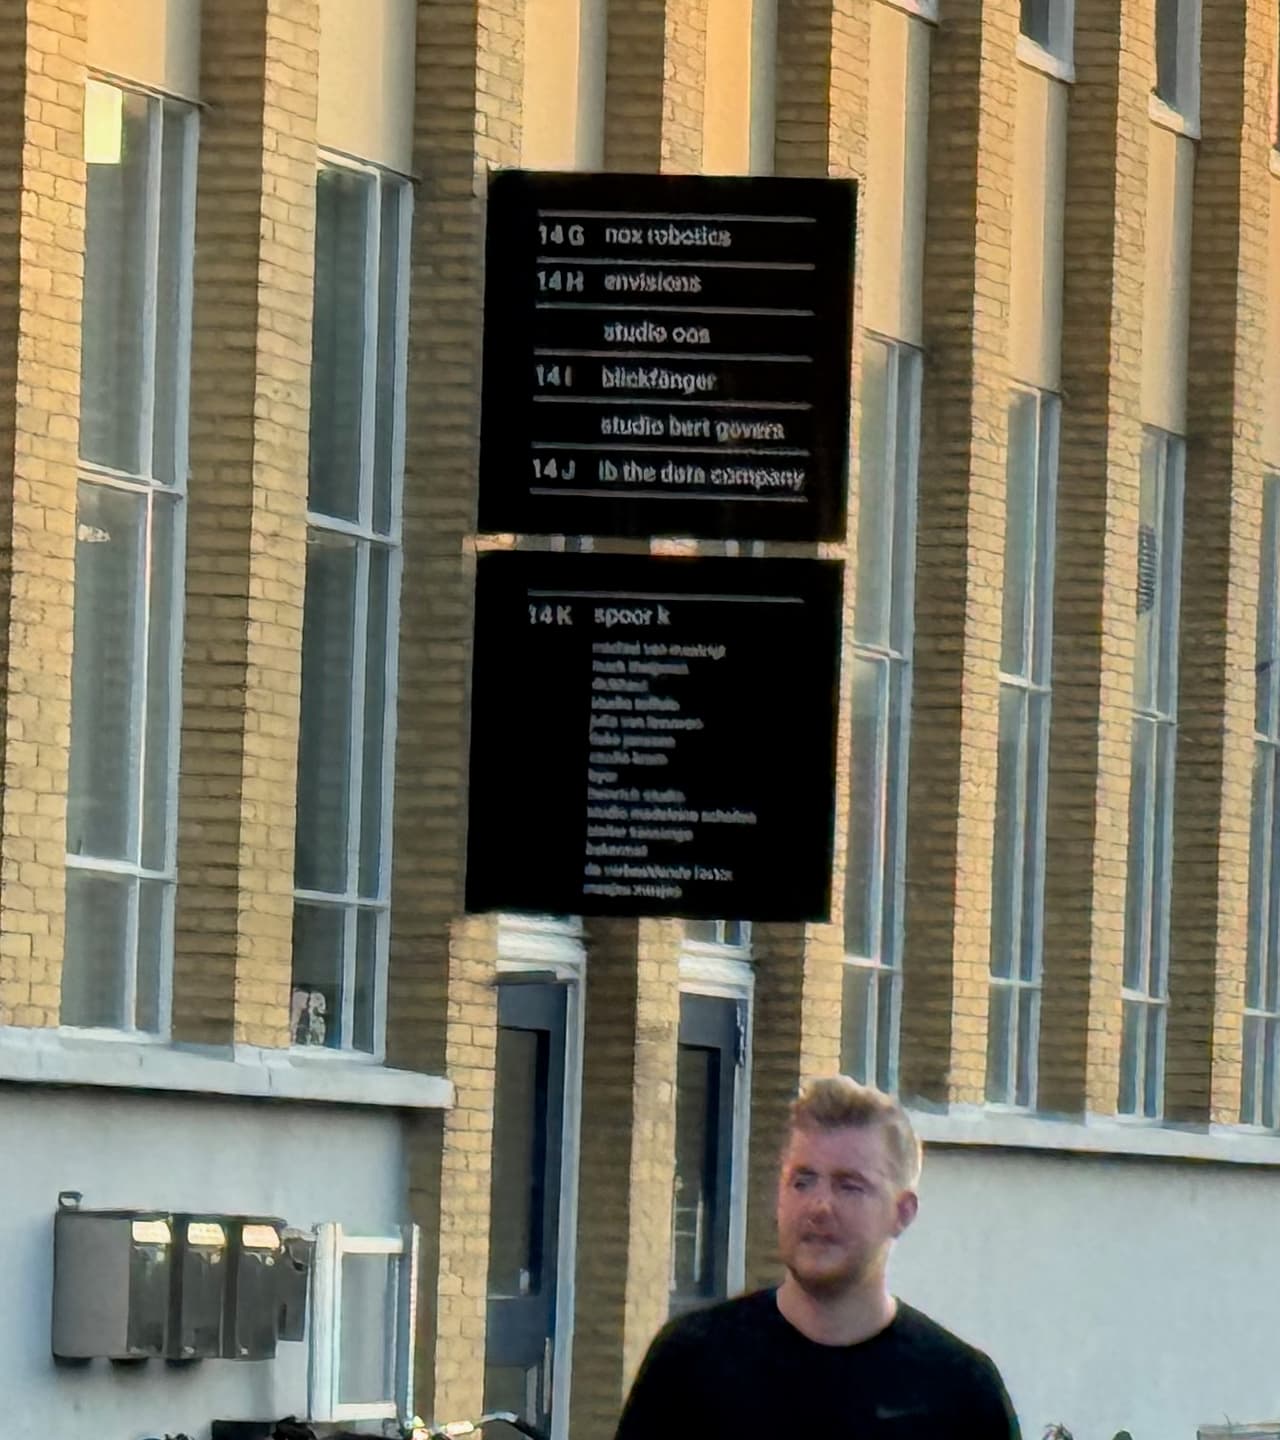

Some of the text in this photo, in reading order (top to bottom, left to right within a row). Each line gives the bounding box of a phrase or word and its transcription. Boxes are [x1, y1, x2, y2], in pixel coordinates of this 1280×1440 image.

[604, 321, 668, 343] studio
[601, 414, 664, 436] studio
[623, 460, 656, 482] the
[661, 460, 705, 484] data
[710, 467, 805, 491] company
